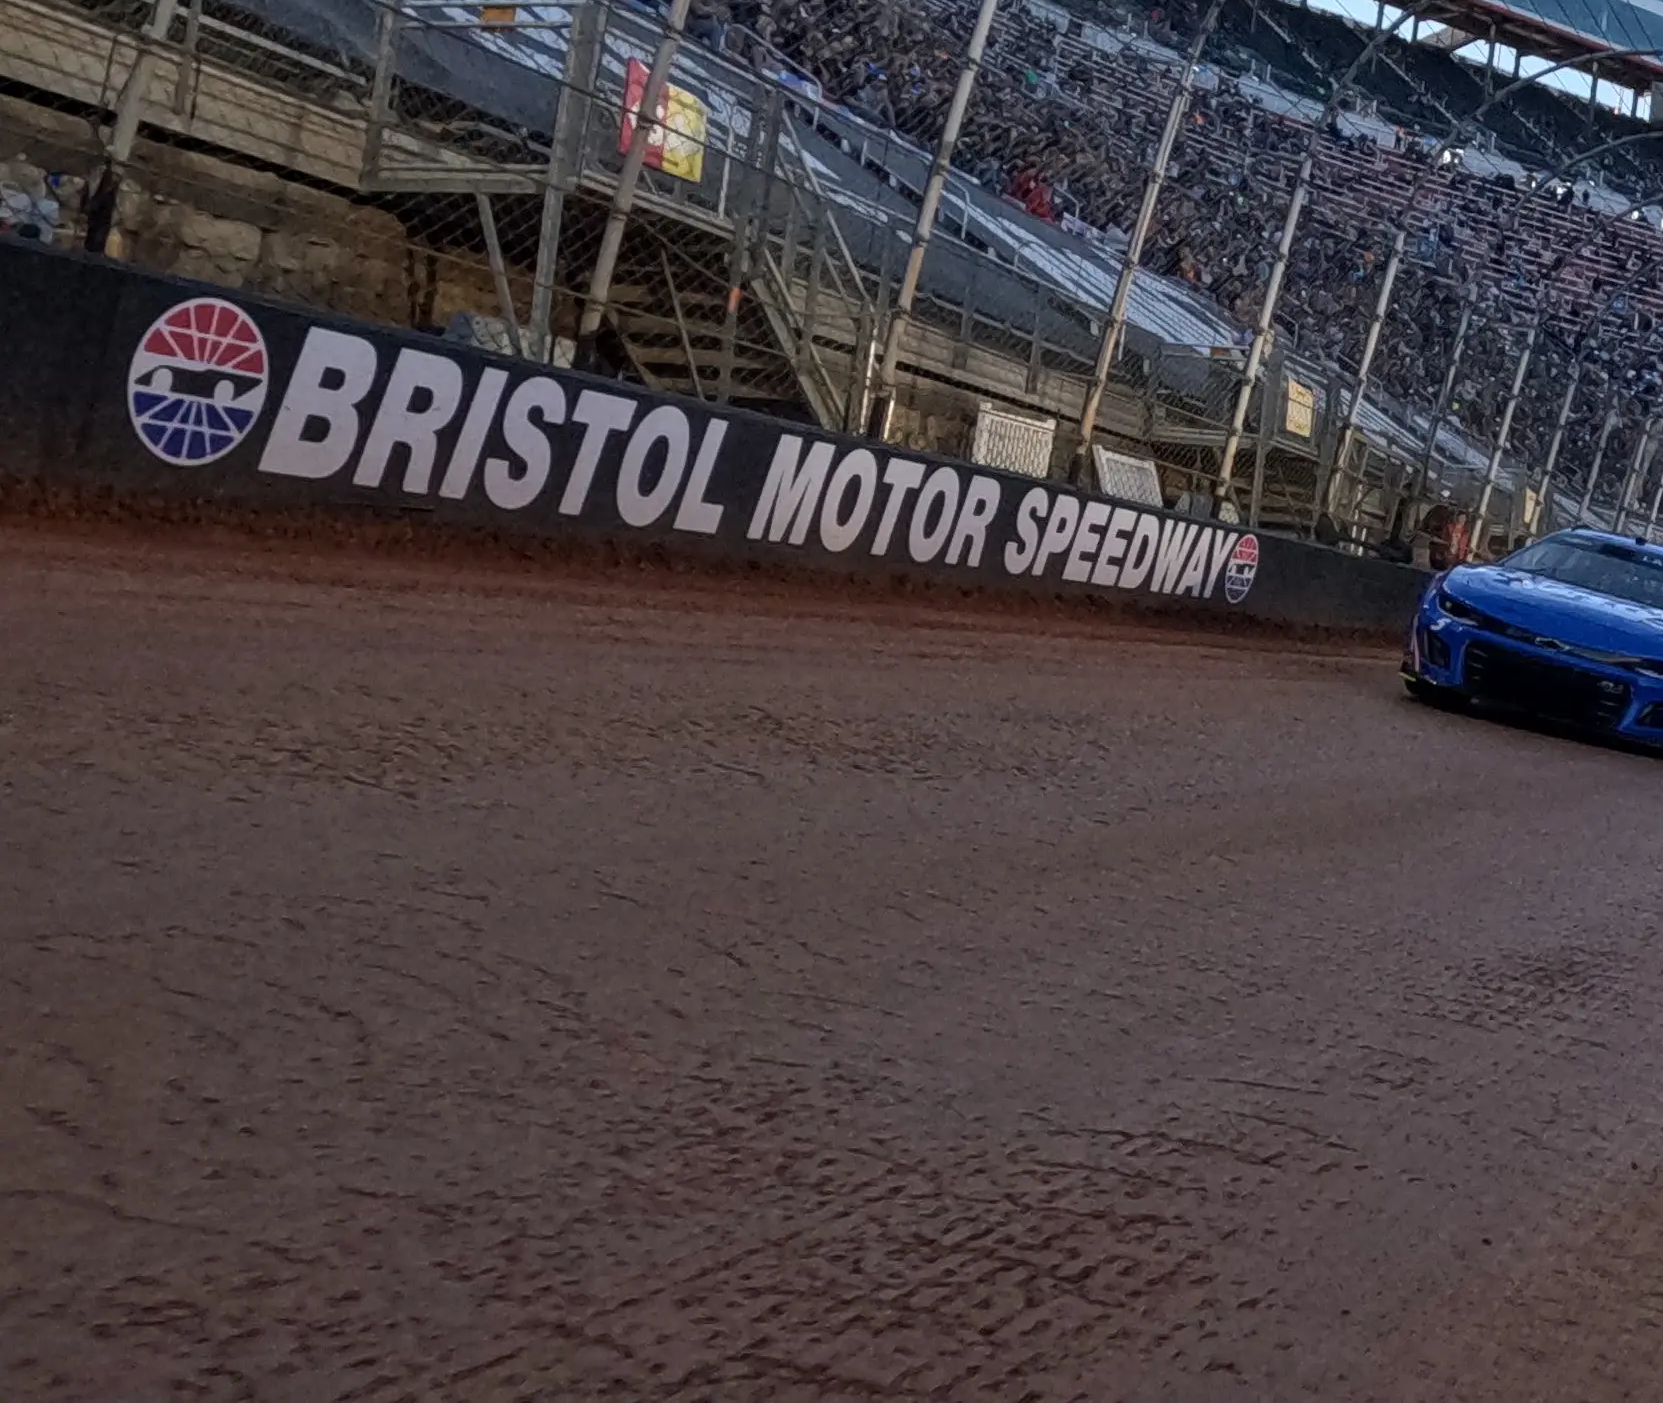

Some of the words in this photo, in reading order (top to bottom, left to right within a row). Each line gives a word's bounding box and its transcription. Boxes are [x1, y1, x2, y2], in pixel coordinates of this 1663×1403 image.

[258, 326, 729, 535] BRISTOL
[747, 433, 1001, 568] MOTOR
[1004, 487, 1239, 598] SPEEDWAY
